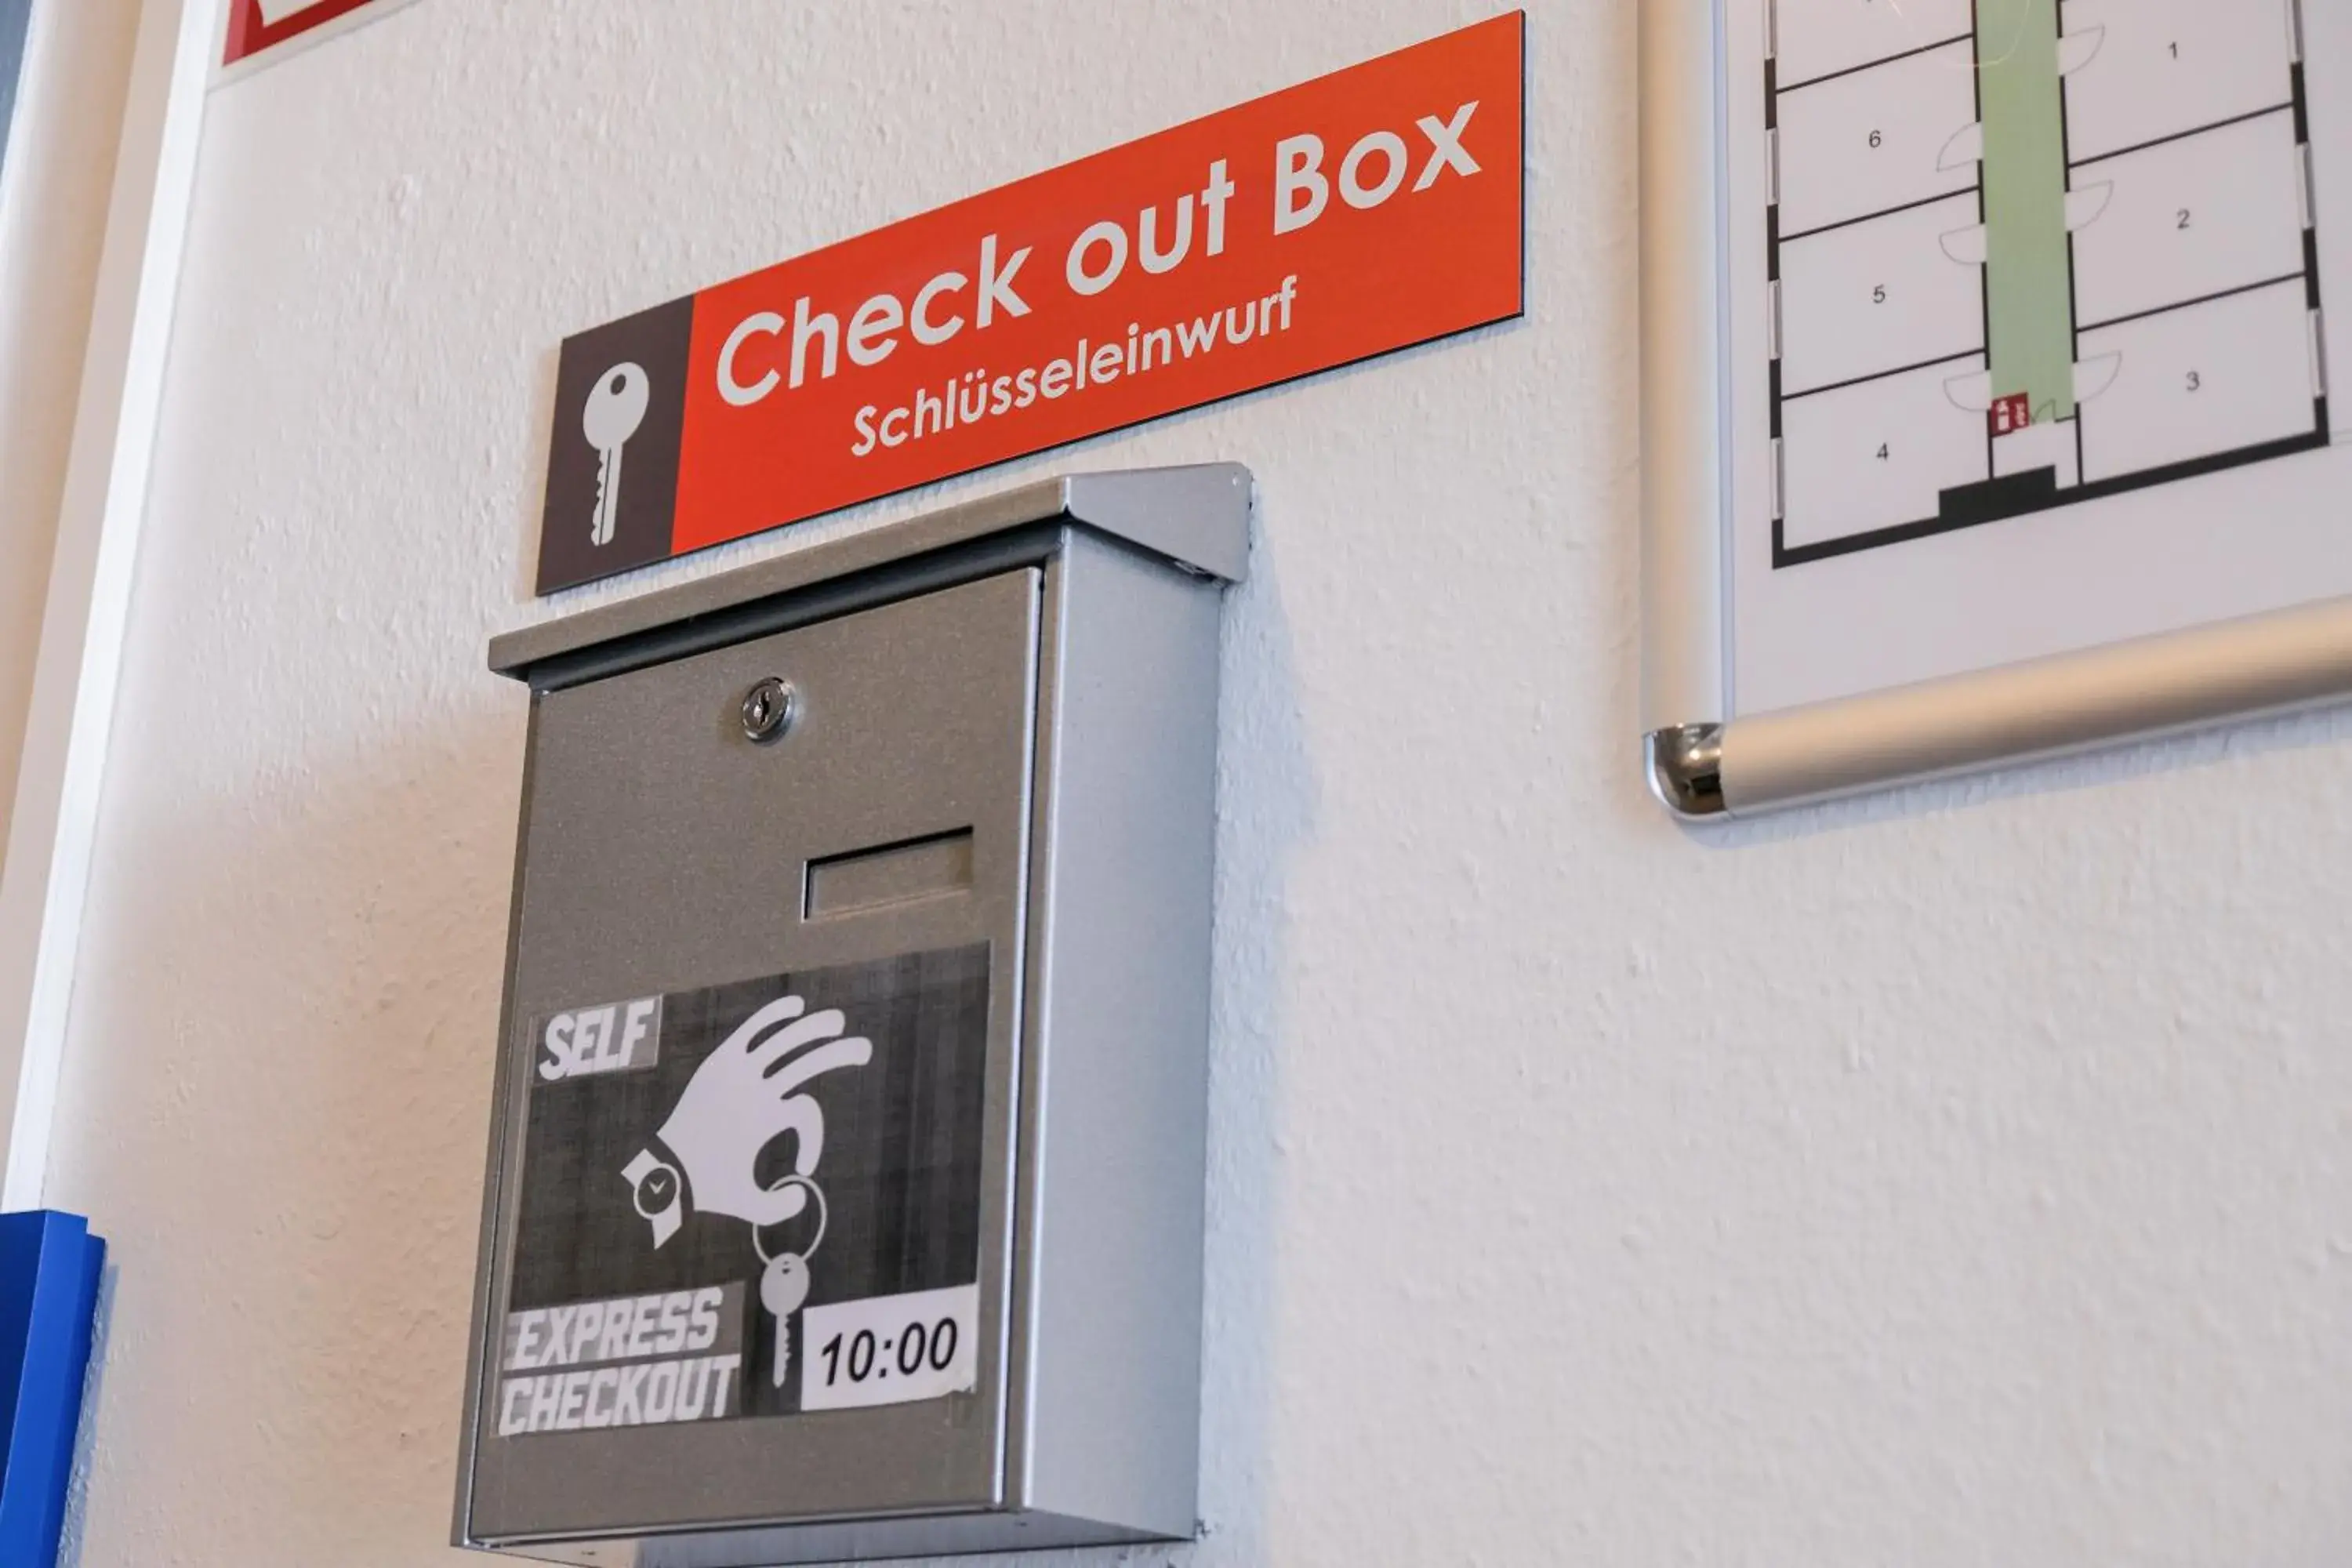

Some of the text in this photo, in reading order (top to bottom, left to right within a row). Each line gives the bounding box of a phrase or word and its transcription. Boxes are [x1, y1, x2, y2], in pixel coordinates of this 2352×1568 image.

[2169, 42, 2178, 59] 1
[1868, 129, 1882, 149] 6
[2176, 209, 2190, 230] 2
[717, 100, 1481, 407] Check out Box
[1873, 285, 1886, 304] 5
[851, 277, 1298, 457] Schlüsseleinwurf
[2187, 371, 2200, 391] 3
[1876, 442, 1889, 461] 4
[539, 1000, 655, 1080] SELF
[512, 1287, 723, 1369] EXPRESS
[822, 1317, 958, 1386] 10:00
[499, 1354, 740, 1436] CHECKOUT
